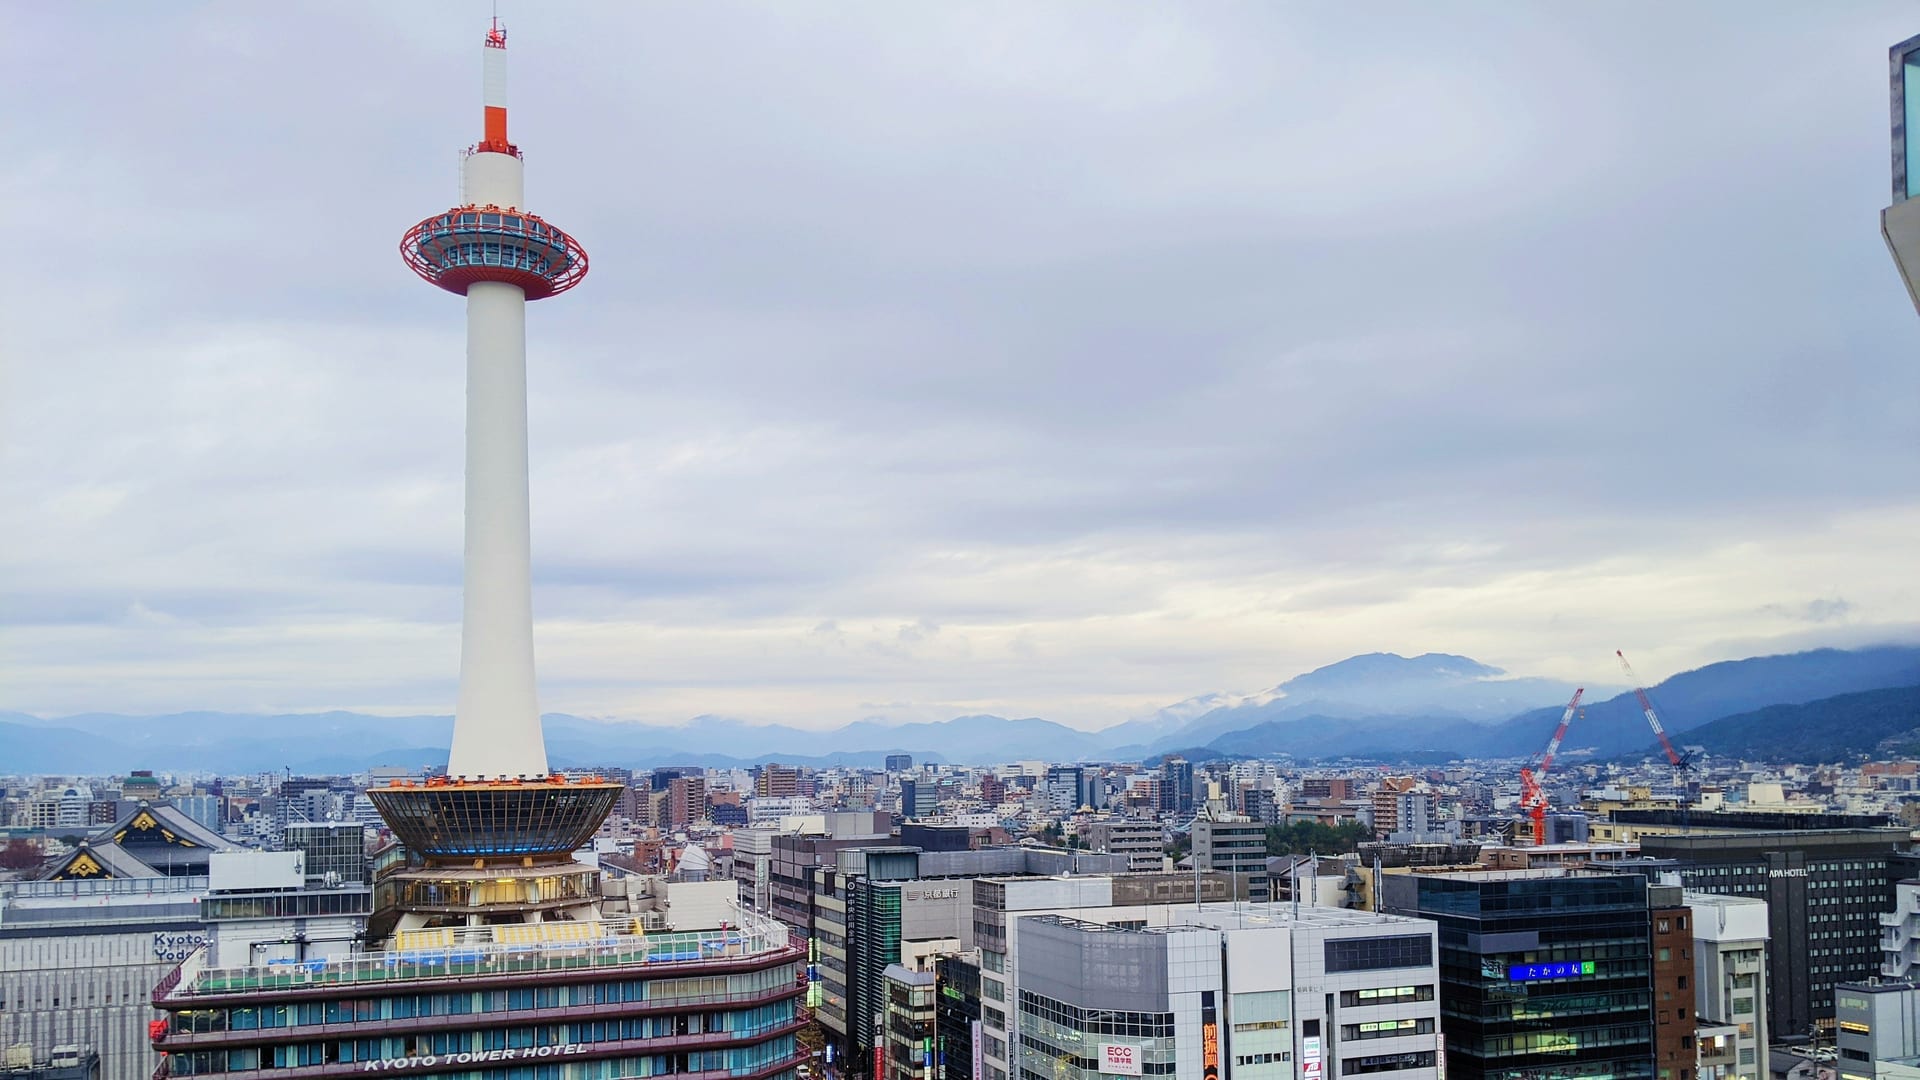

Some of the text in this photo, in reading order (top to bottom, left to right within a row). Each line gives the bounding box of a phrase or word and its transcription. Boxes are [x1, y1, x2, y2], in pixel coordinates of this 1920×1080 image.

[1769, 868, 1808, 878] APA HOTEL
[923, 888, 958, 899] 京都銀行
[154, 933, 202, 947] Kyoto
[1107, 1046, 1132, 1057] ECC
[364, 1043, 588, 1072] KYOTO TOWER HOTEL
